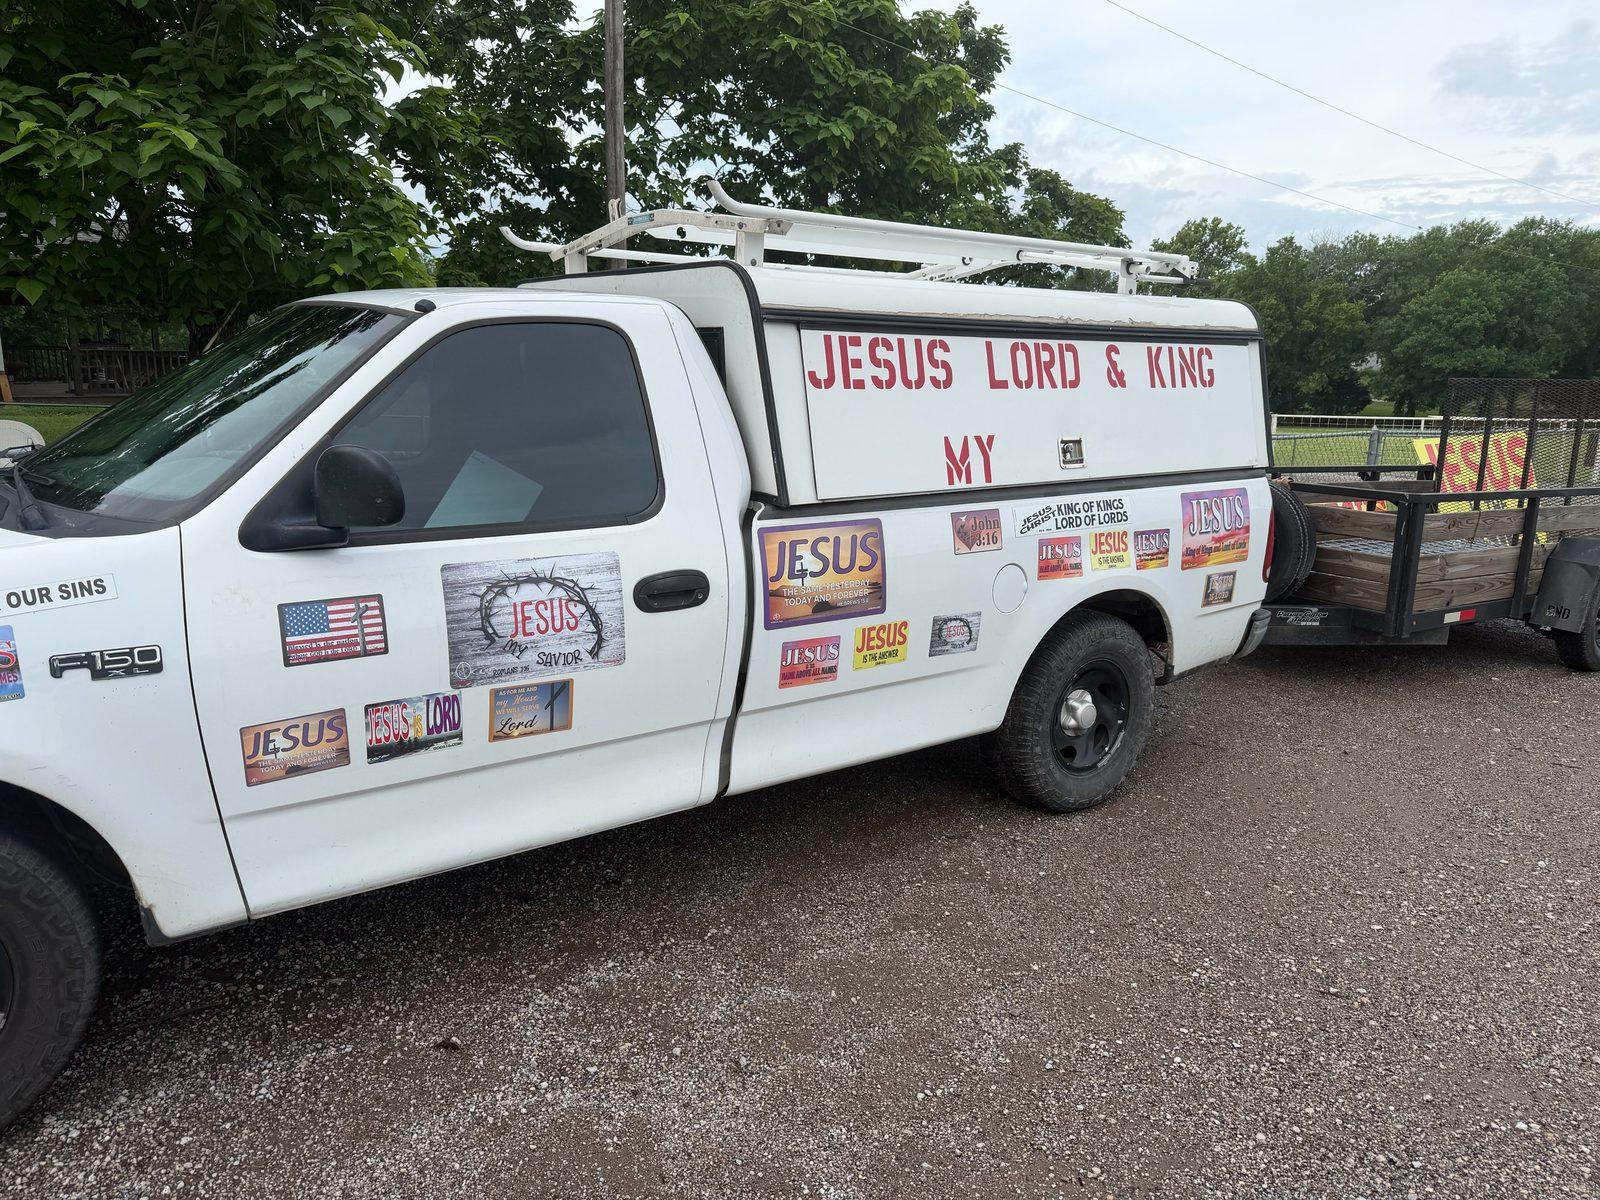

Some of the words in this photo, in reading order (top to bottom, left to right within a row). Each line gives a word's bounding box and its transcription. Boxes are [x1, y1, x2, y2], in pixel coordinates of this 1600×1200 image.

[808, 334, 954, 390] JESUS
[985, 340, 1081, 390] LORD
[1105, 343, 1126, 389] &
[1145, 345, 1215, 389] KING
[944, 434, 995, 485] MY
[1022, 505, 1052, 527] JESUS
[1056, 503, 1080, 516] KING
[1082, 501, 1094, 513] OF
[1096, 499, 1124, 511] KINGS
[1189, 495, 1244, 536] JESUS
[972, 515, 1000, 531] John
[1020, 510, 1057, 535] CHRIST
[1055, 516, 1082, 530] LORD
[1084, 514, 1096, 526] OF
[1098, 511, 1129, 525] LORDS
[976, 531, 998, 547] 3:16
[1091, 531, 1129, 555] JESUS
[1136, 532, 1169, 552] JESUS
[769, 532, 880, 583] JESUS
[1039, 542, 1081, 560] JESUS
[6, 587, 53, 609] OUR
[58, 578, 107, 600] SINS
[783, 588, 799, 597] THE
[801, 585, 824, 594] SAME
[825, 579, 870, 591] YESTERDAY
[785, 596, 812, 606] TODAY
[814, 594, 832, 603] AND
[833, 589, 869, 600] FOREVER
[510, 598, 580, 639] JESUS
[856, 621, 908, 653] JESUS
[946, 625, 965, 639] JESUS
[536, 650, 583, 667] SAVIOR
[781, 643, 840, 667] JESUS
[863, 654, 868, 663] IS
[869, 652, 878, 662] THE
[878, 649, 899, 660] ANSWER
[368, 703, 411, 747] JESUS
[412, 708, 424, 738] is
[426, 694, 461, 735] LORD
[496, 714, 538, 735] Lord
[247, 715, 344, 760] JESUS
[261, 765, 284, 773] TODAY
[286, 760, 303, 768] AND
[304, 753, 337, 765] FOREVER
